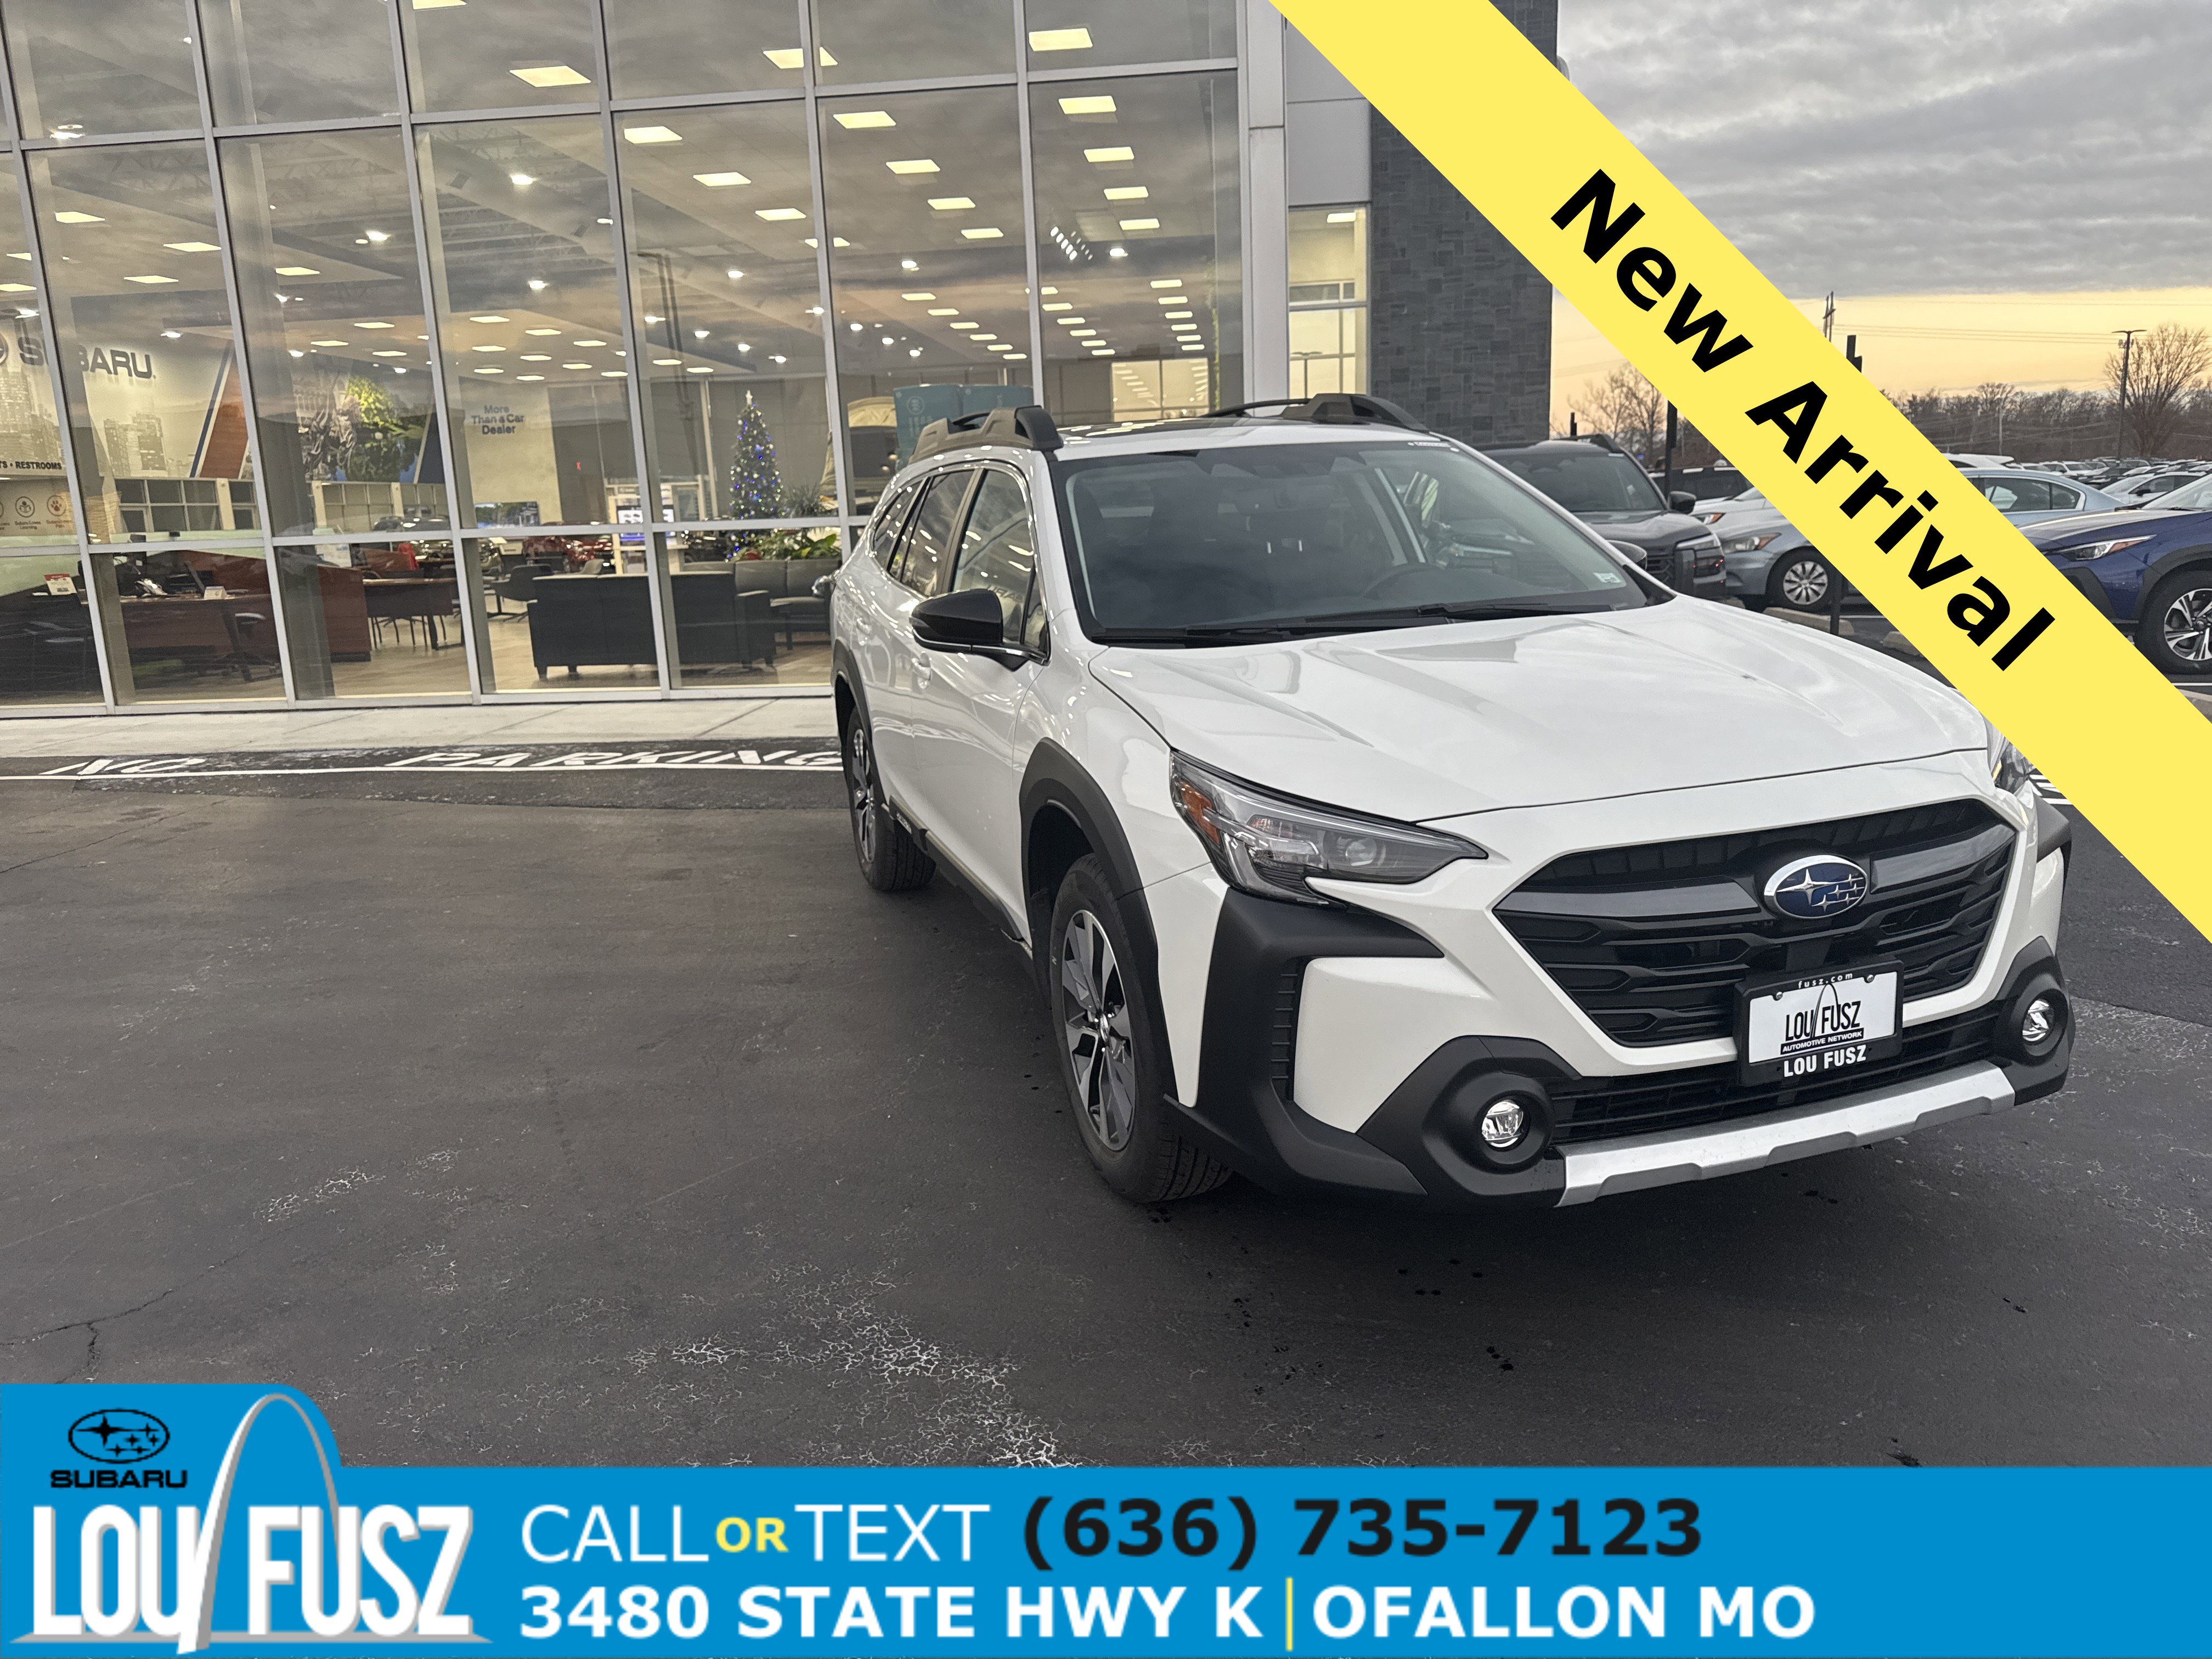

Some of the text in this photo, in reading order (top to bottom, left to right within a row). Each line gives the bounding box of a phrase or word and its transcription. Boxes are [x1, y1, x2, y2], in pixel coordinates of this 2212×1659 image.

[18, 336, 153, 379] SBARU
[484, 405, 510, 414] More
[471, 415, 498, 424] Than
[506, 414, 524, 423] Car
[482, 425, 516, 435] Dealer
[15, 461, 62, 470] RESTROOMS
[38, 758, 206, 775] NO
[386, 751, 841, 768] PARKING
[1798, 973, 1853, 989] fusz.com
[1785, 1001, 1861, 1042] LOU FUSZ
[1782, 1031, 1863, 1052] AUTOMOTIVE NETWORK
[1784, 1045, 1866, 1077] LOU FUSZ
